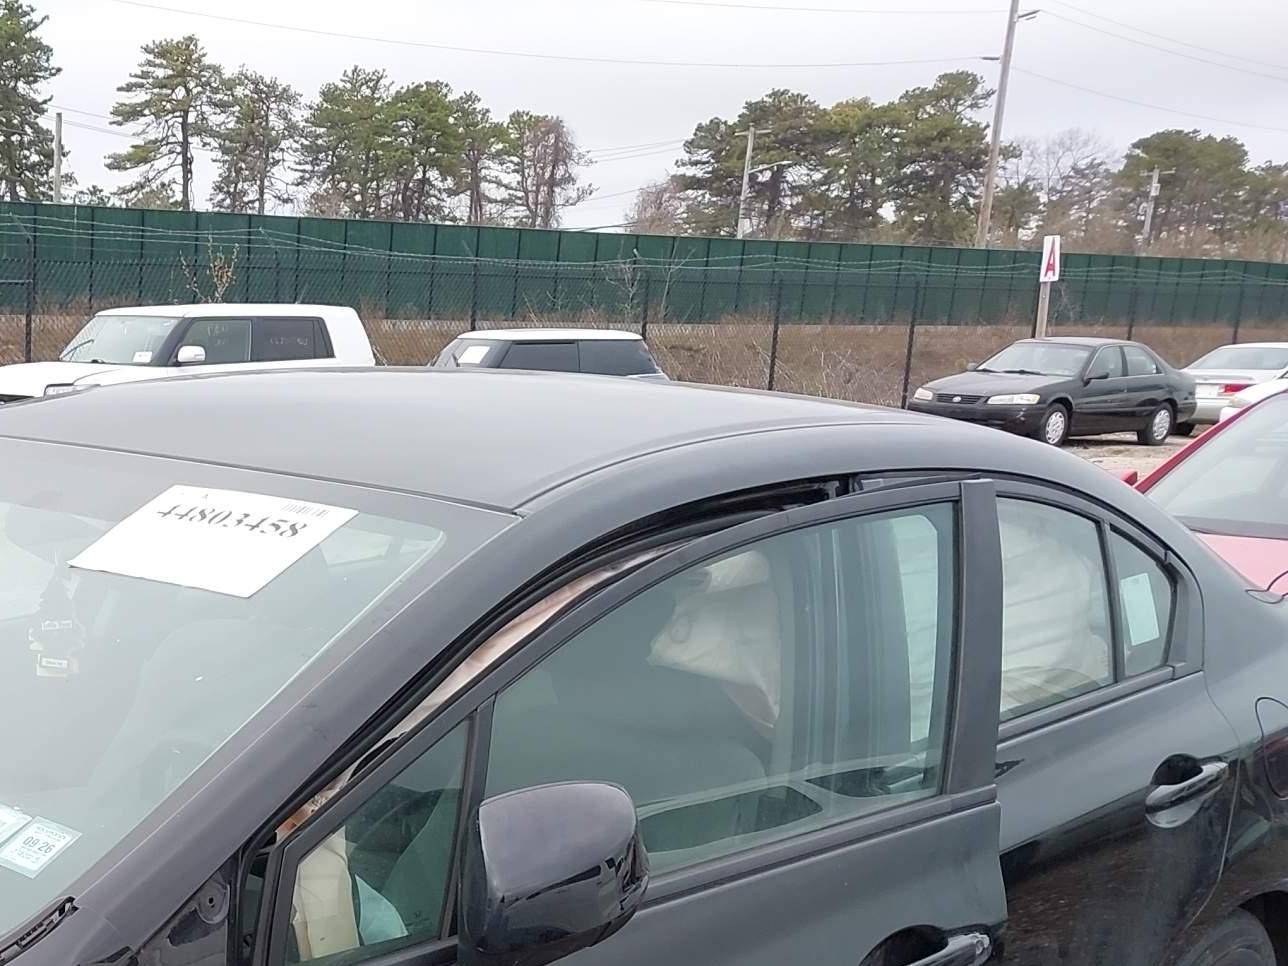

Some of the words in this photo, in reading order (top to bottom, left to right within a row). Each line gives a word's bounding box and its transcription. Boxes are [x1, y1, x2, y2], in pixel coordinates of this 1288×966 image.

[1044, 237, 1056, 278] A
[157, 504, 309, 538] 44803458
[23, 836, 41, 848] 09
[37, 841, 56, 854] 26
